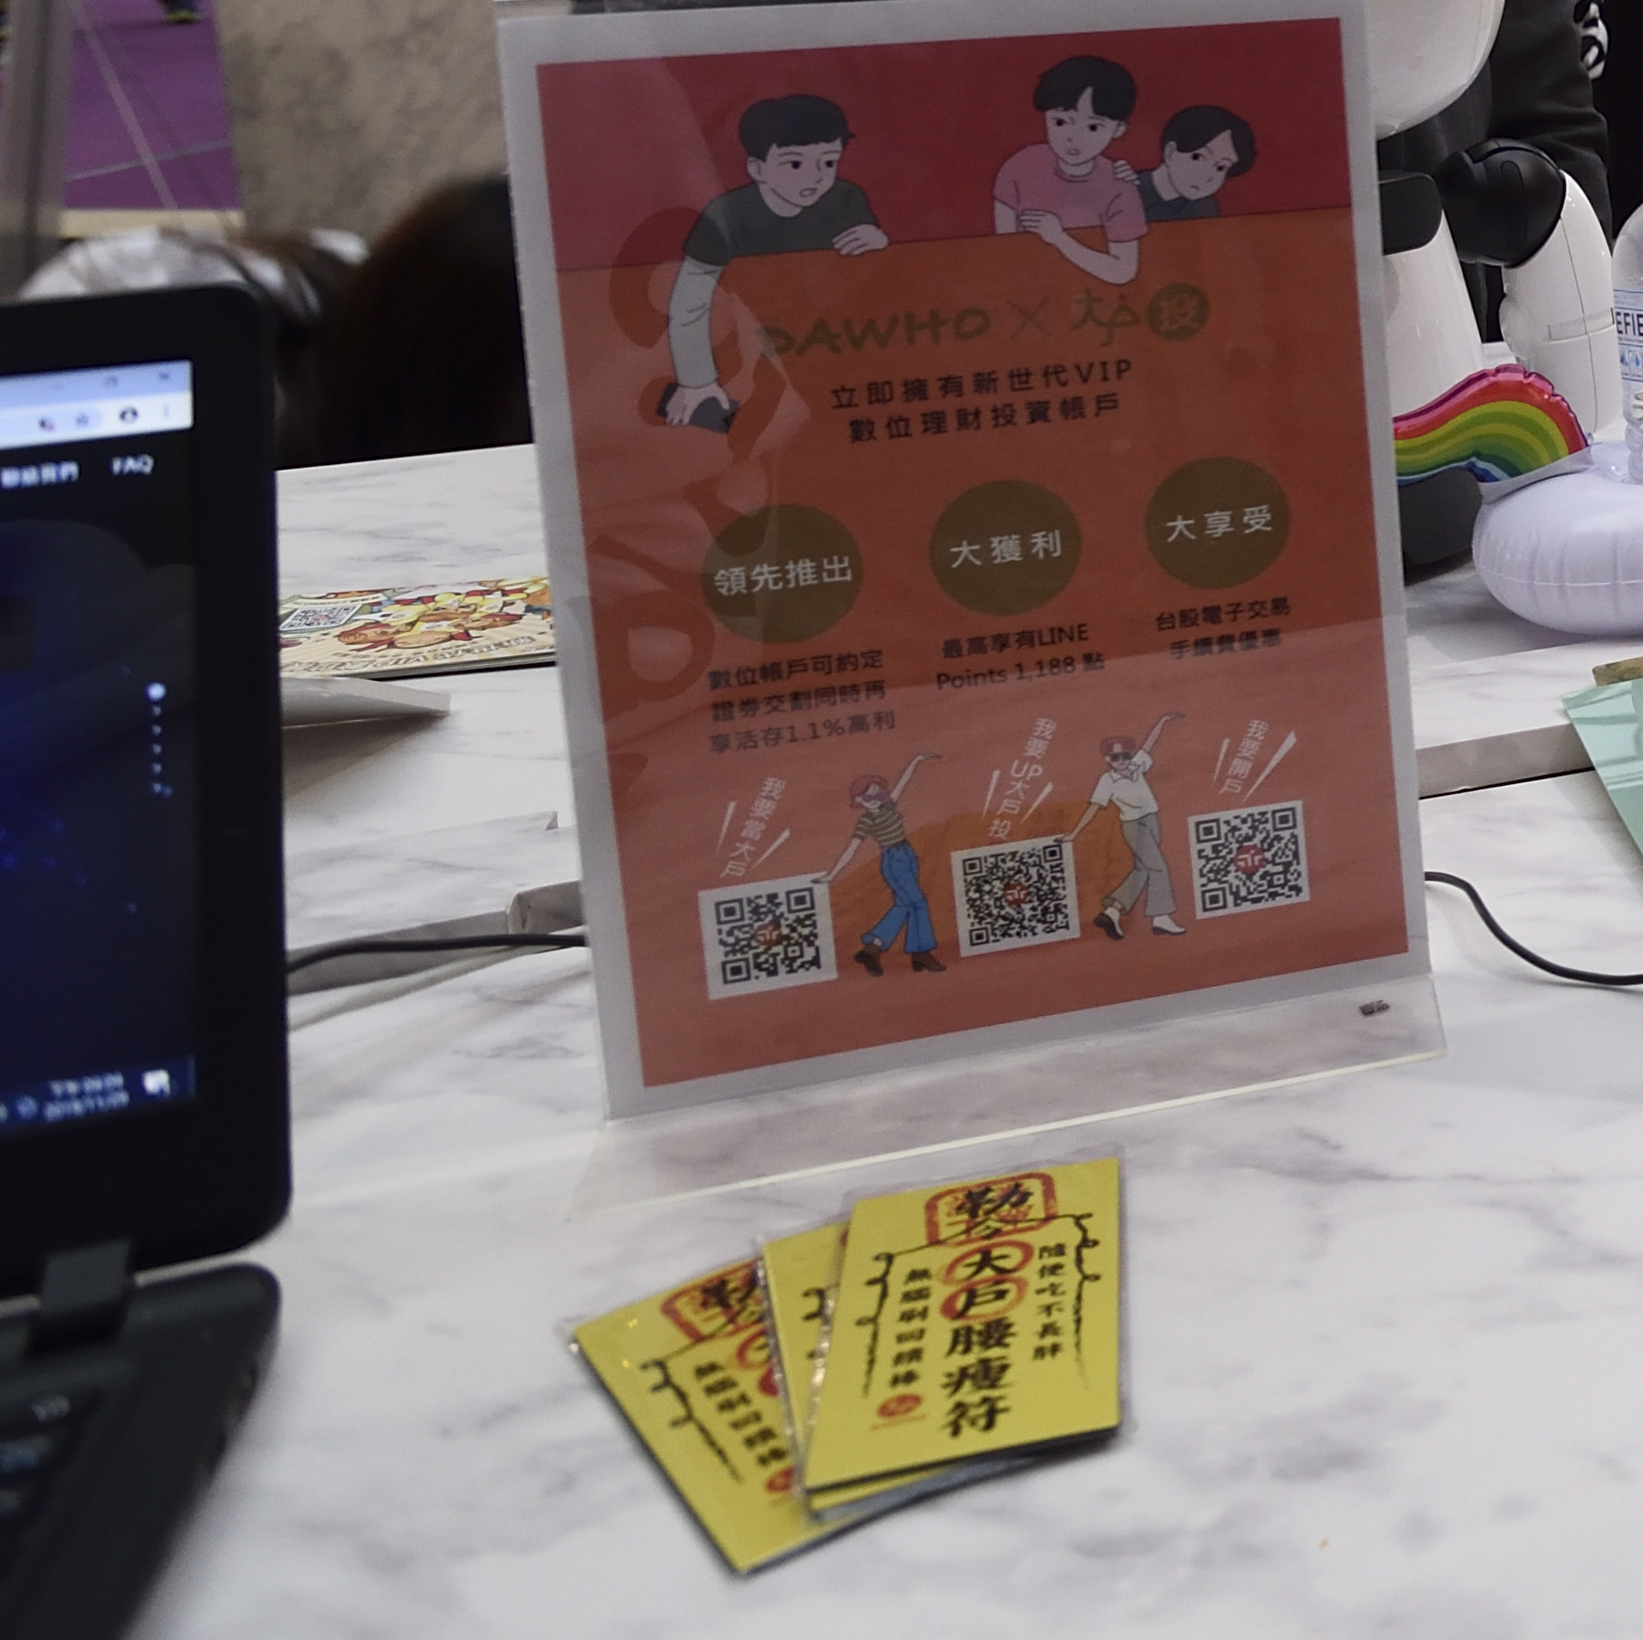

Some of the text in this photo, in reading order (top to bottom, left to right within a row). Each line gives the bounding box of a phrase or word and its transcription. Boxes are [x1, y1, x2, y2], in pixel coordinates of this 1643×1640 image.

[756, 307, 991, 359] DAWHO
[831, 360, 1133, 410] 立即擁有新世代VIP
[849, 394, 1120, 445] 數位理財投資帳戶
[1165, 504, 1275, 544] 大享受
[949, 529, 1063, 570] 大獲利
[714, 553, 853, 597] 領先推出
[1155, 596, 1292, 633] 台股電子交易
[942, 622, 1089, 660] 最高享有LINE
[936, 665, 1008, 692] Points
[1220, 718, 1270, 795] 我要開戶
